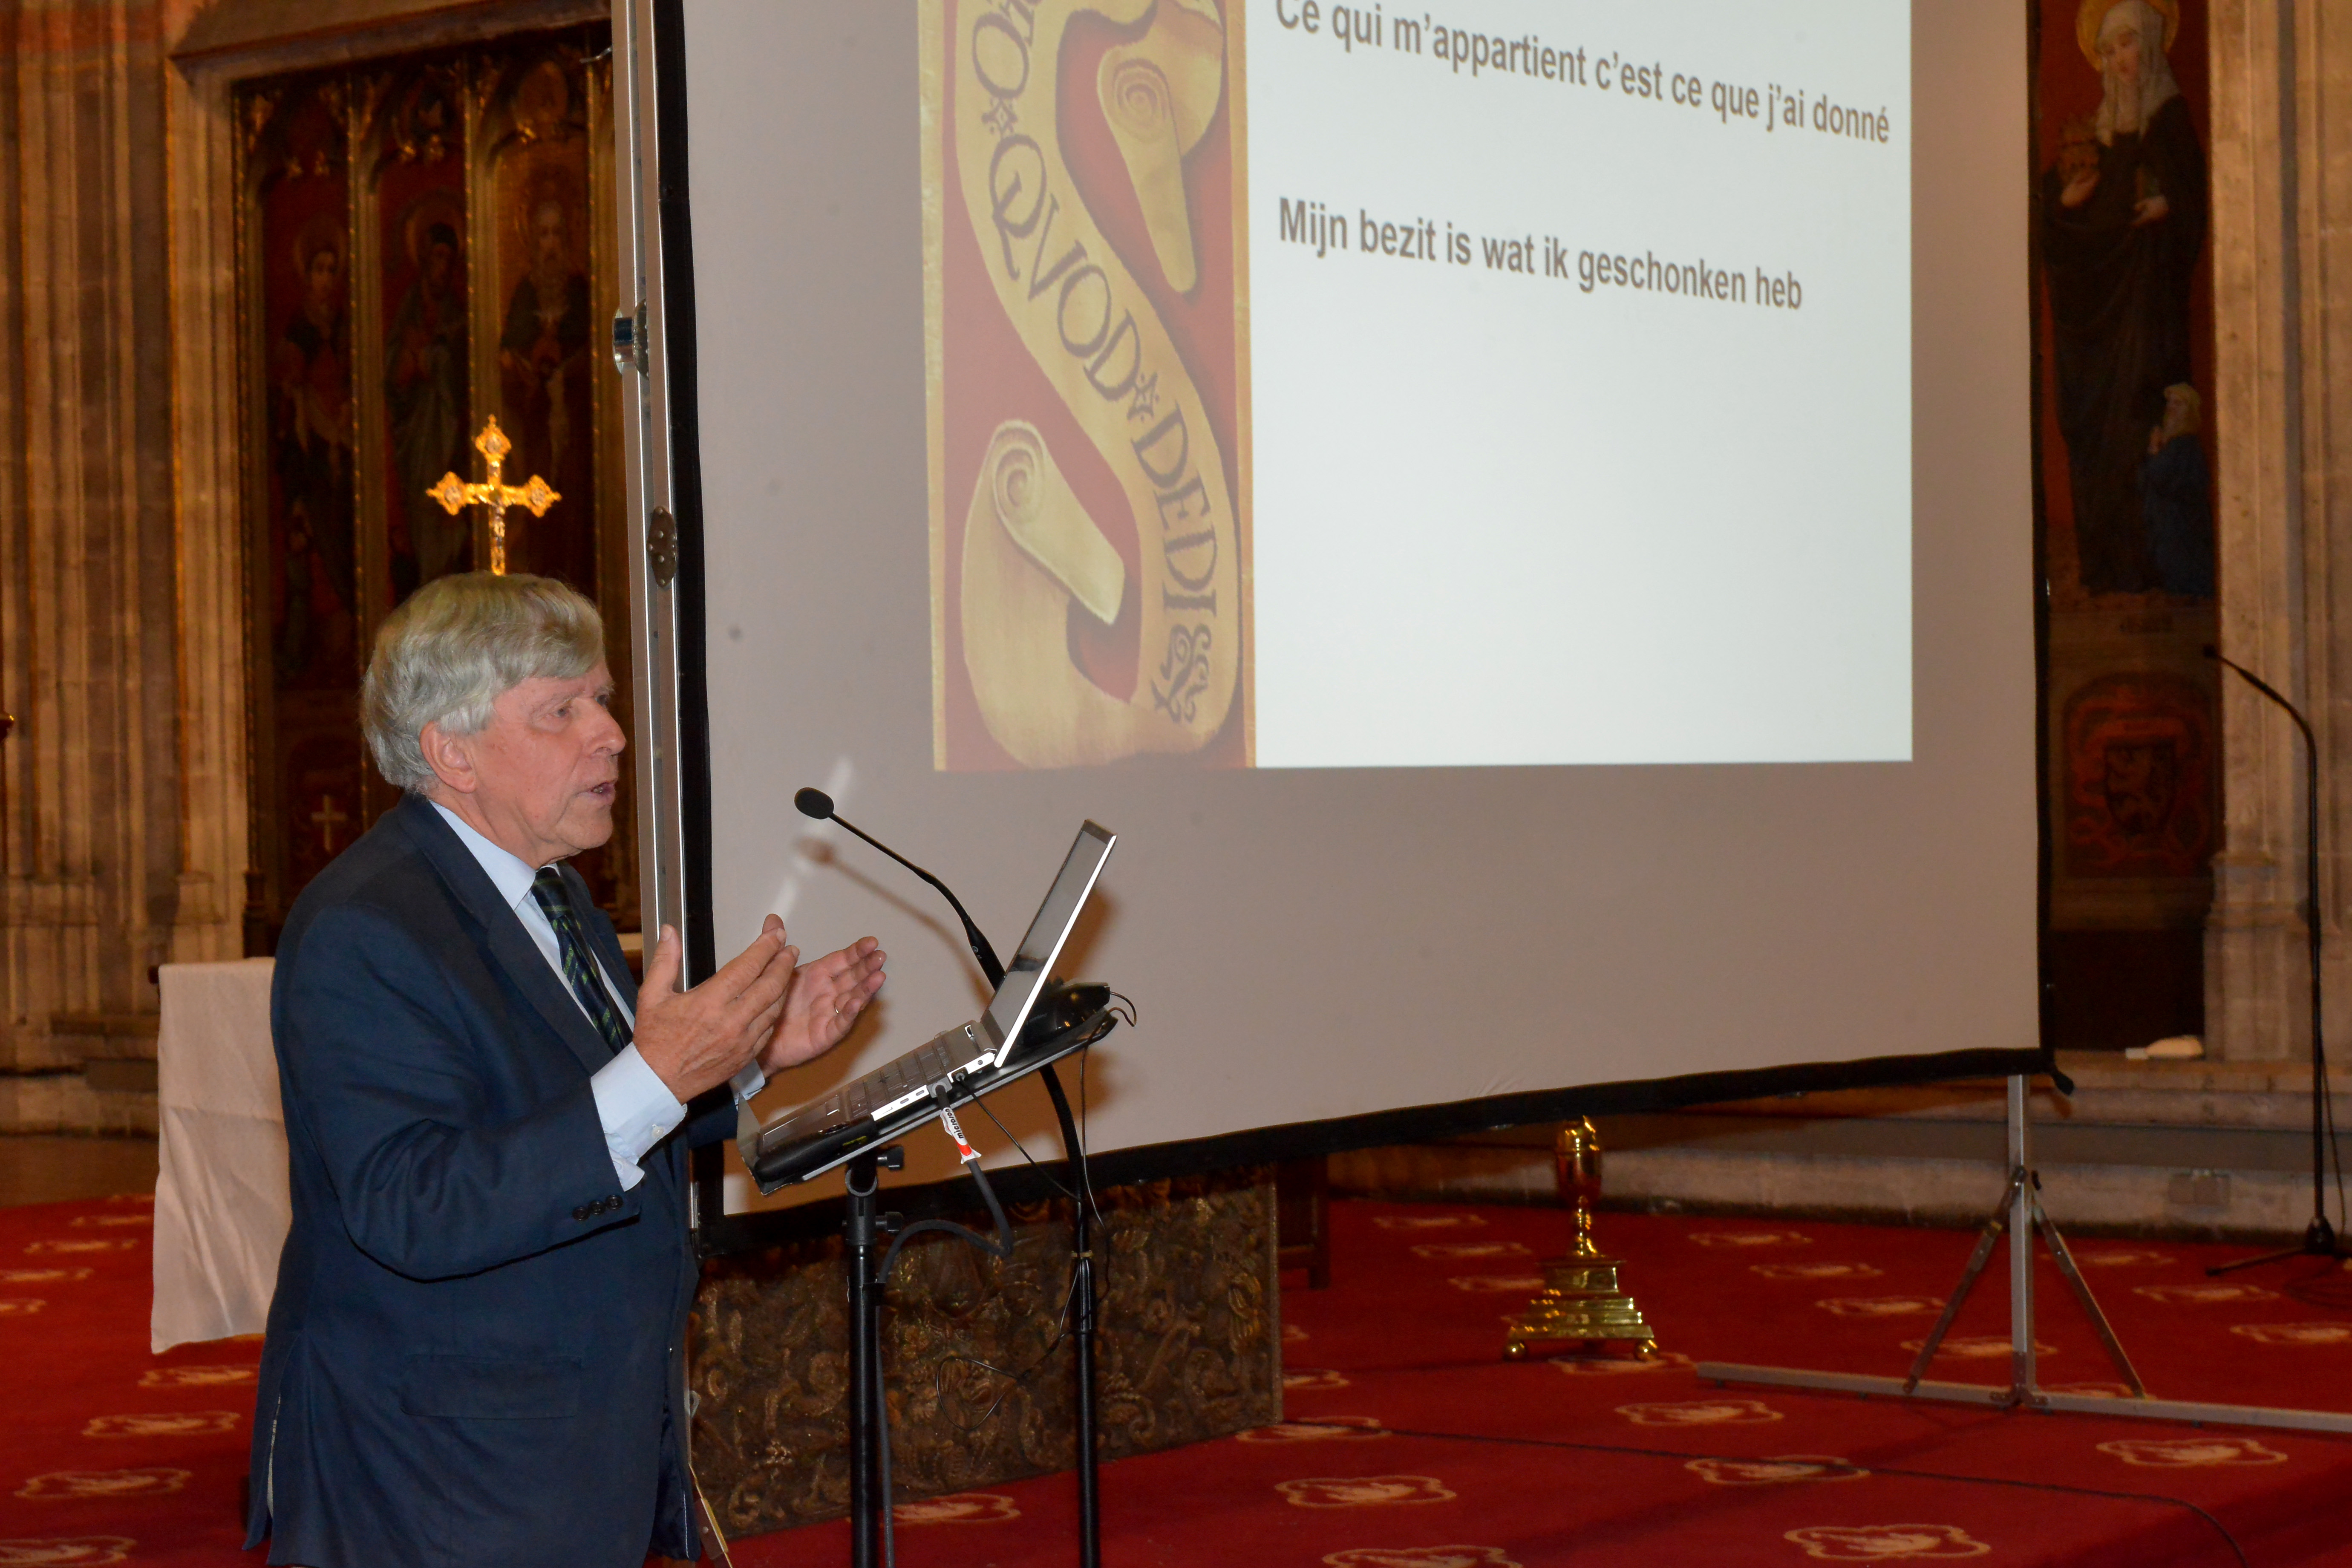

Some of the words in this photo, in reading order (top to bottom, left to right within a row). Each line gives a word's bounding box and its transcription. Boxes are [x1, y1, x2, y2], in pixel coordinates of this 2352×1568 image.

[1275, 0, 1321, 35] Ce
[1332, 3, 1382, 54] qui
[1394, 12, 1587, 86] m’appartient
[1595, 51, 1663, 101] c’est
[1671, 72, 1703, 108] ce
[1711, 81, 1760, 124] que
[1766, 83, 1804, 133] j’ai
[1813, 93, 1890, 144] donné
[1279, 196, 1348, 259] Mijn
[1360, 208, 1437, 262] bezit
[1446, 221, 1472, 266] is
[1482, 234, 1536, 275] wat
[1544, 235, 1569, 280] ik
[1578, 250, 1747, 303] geschonken
[1755, 266, 1802, 311] heb
[1131, 399, 1218, 617] DEDI
[945, 1108, 964, 1139] microson
